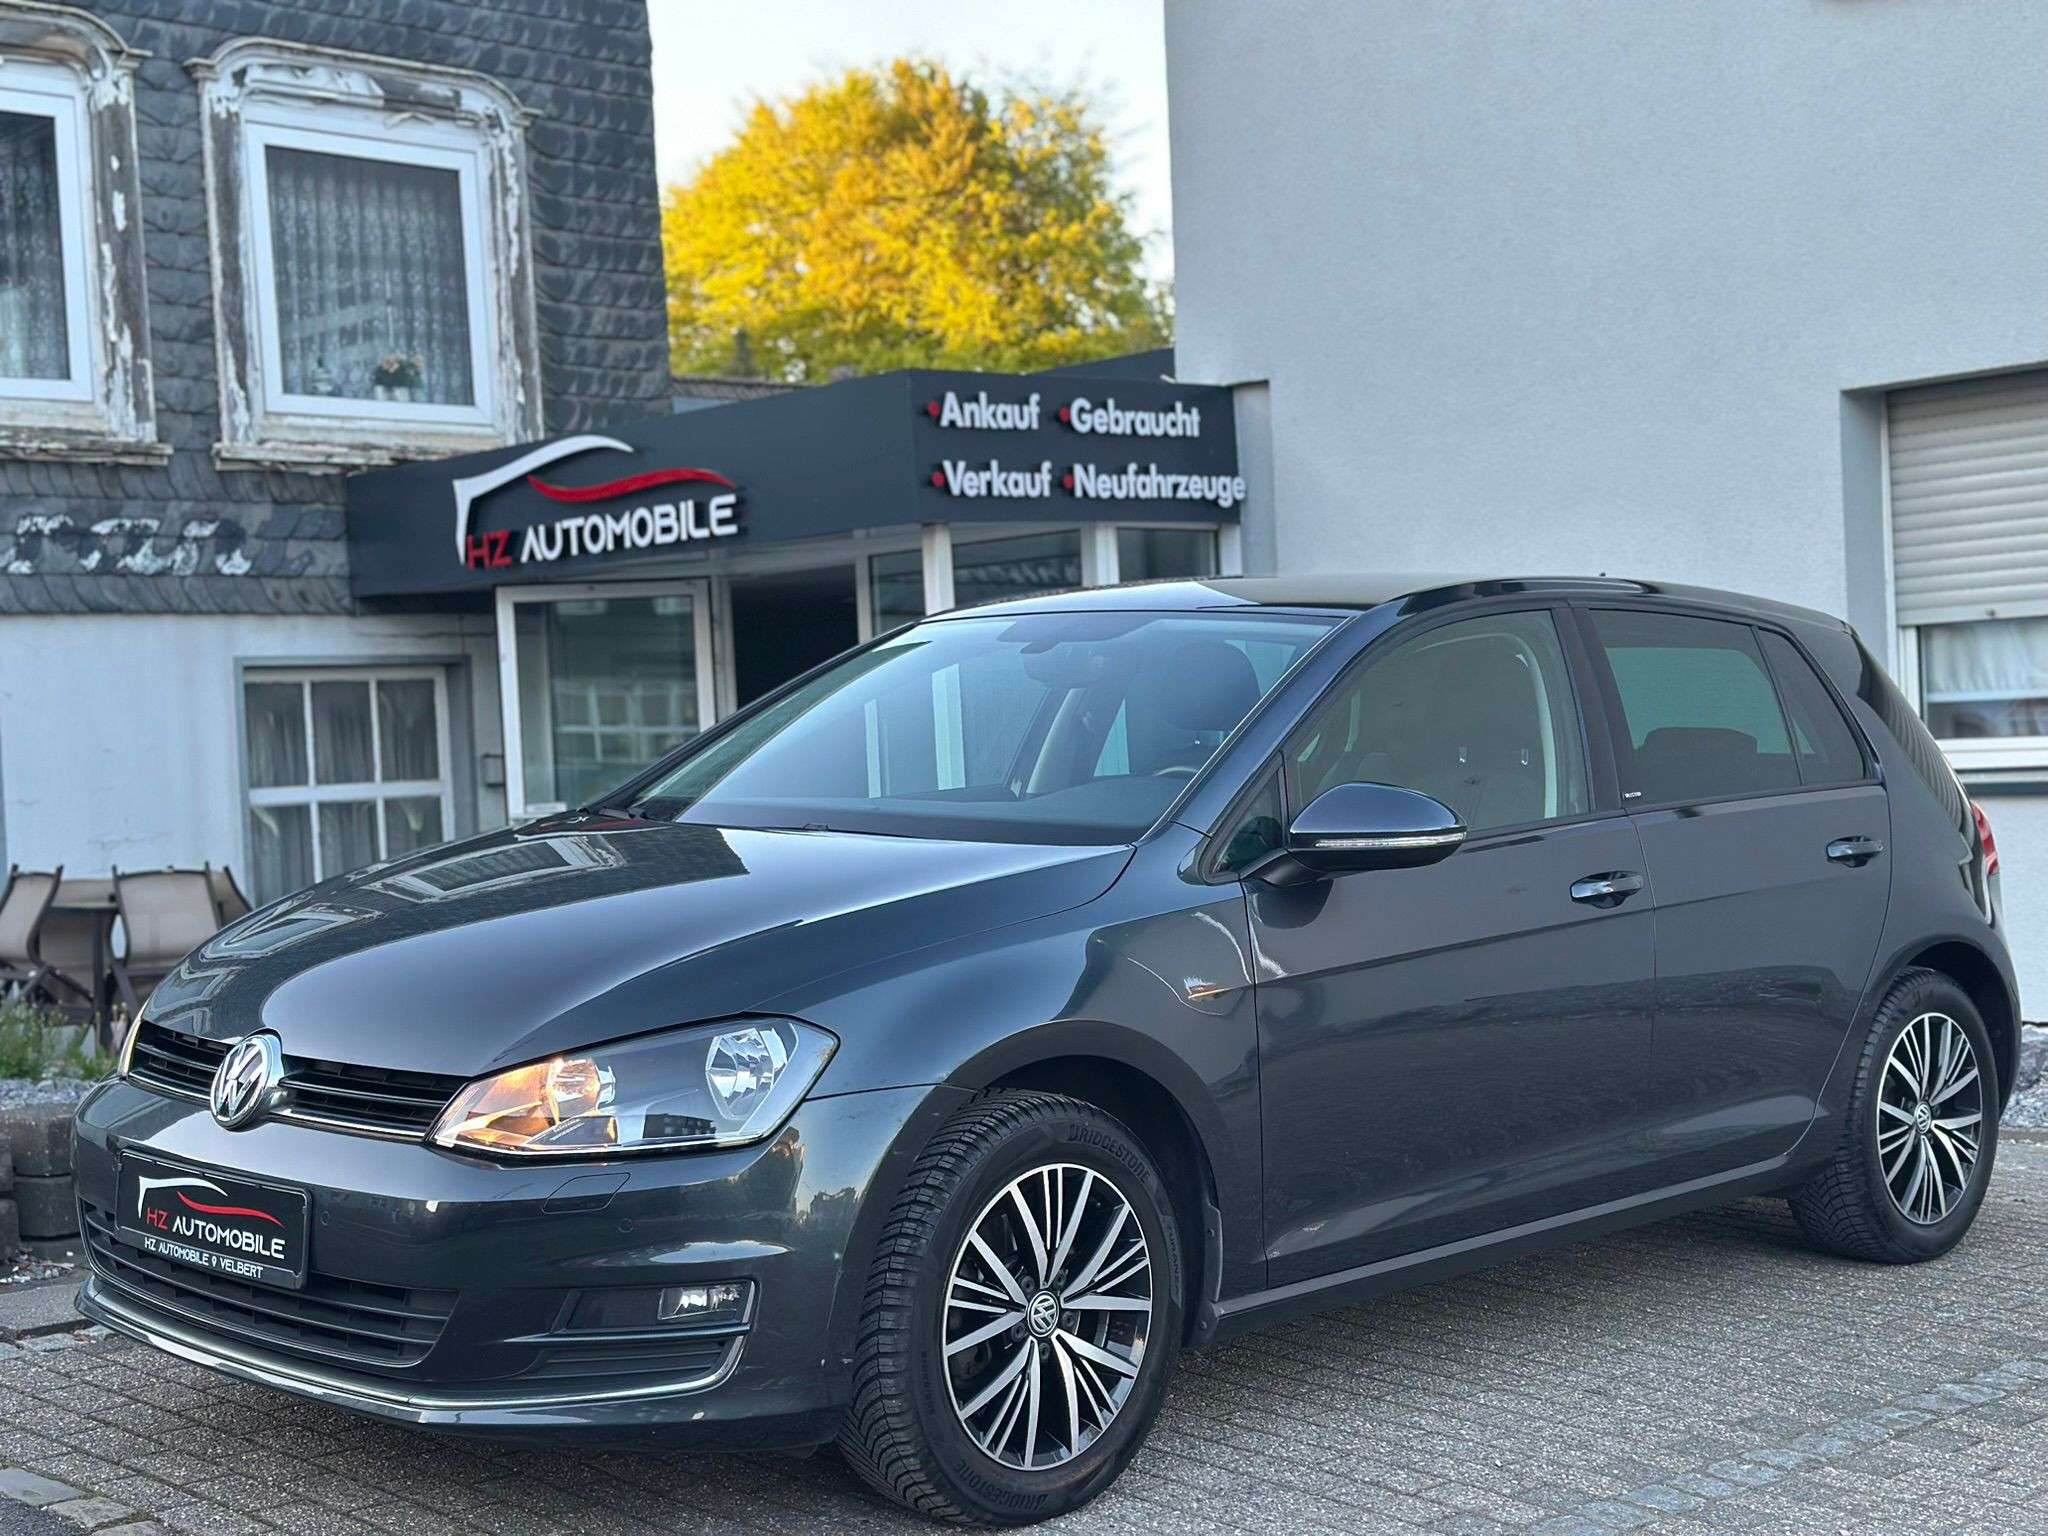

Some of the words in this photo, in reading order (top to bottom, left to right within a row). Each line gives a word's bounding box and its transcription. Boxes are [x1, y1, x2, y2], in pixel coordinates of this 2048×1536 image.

[940, 391, 1040, 430] Ankauf
[1070, 398, 1200, 437] Gebraucht
[943, 459, 1052, 498] Verkauf
[1073, 462, 1246, 508] Neufahrzeuge
[466, 529, 513, 571] HZ
[521, 494, 739, 564] AUTOMOBILE
[146, 1207, 169, 1230] HZ
[172, 1215, 286, 1259] AUTOMOBILE
[144, 1238, 157, 1251] HZ
[158, 1243, 209, 1266] AUTOMOBILE
[220, 1258, 264, 1279] VELBERT
